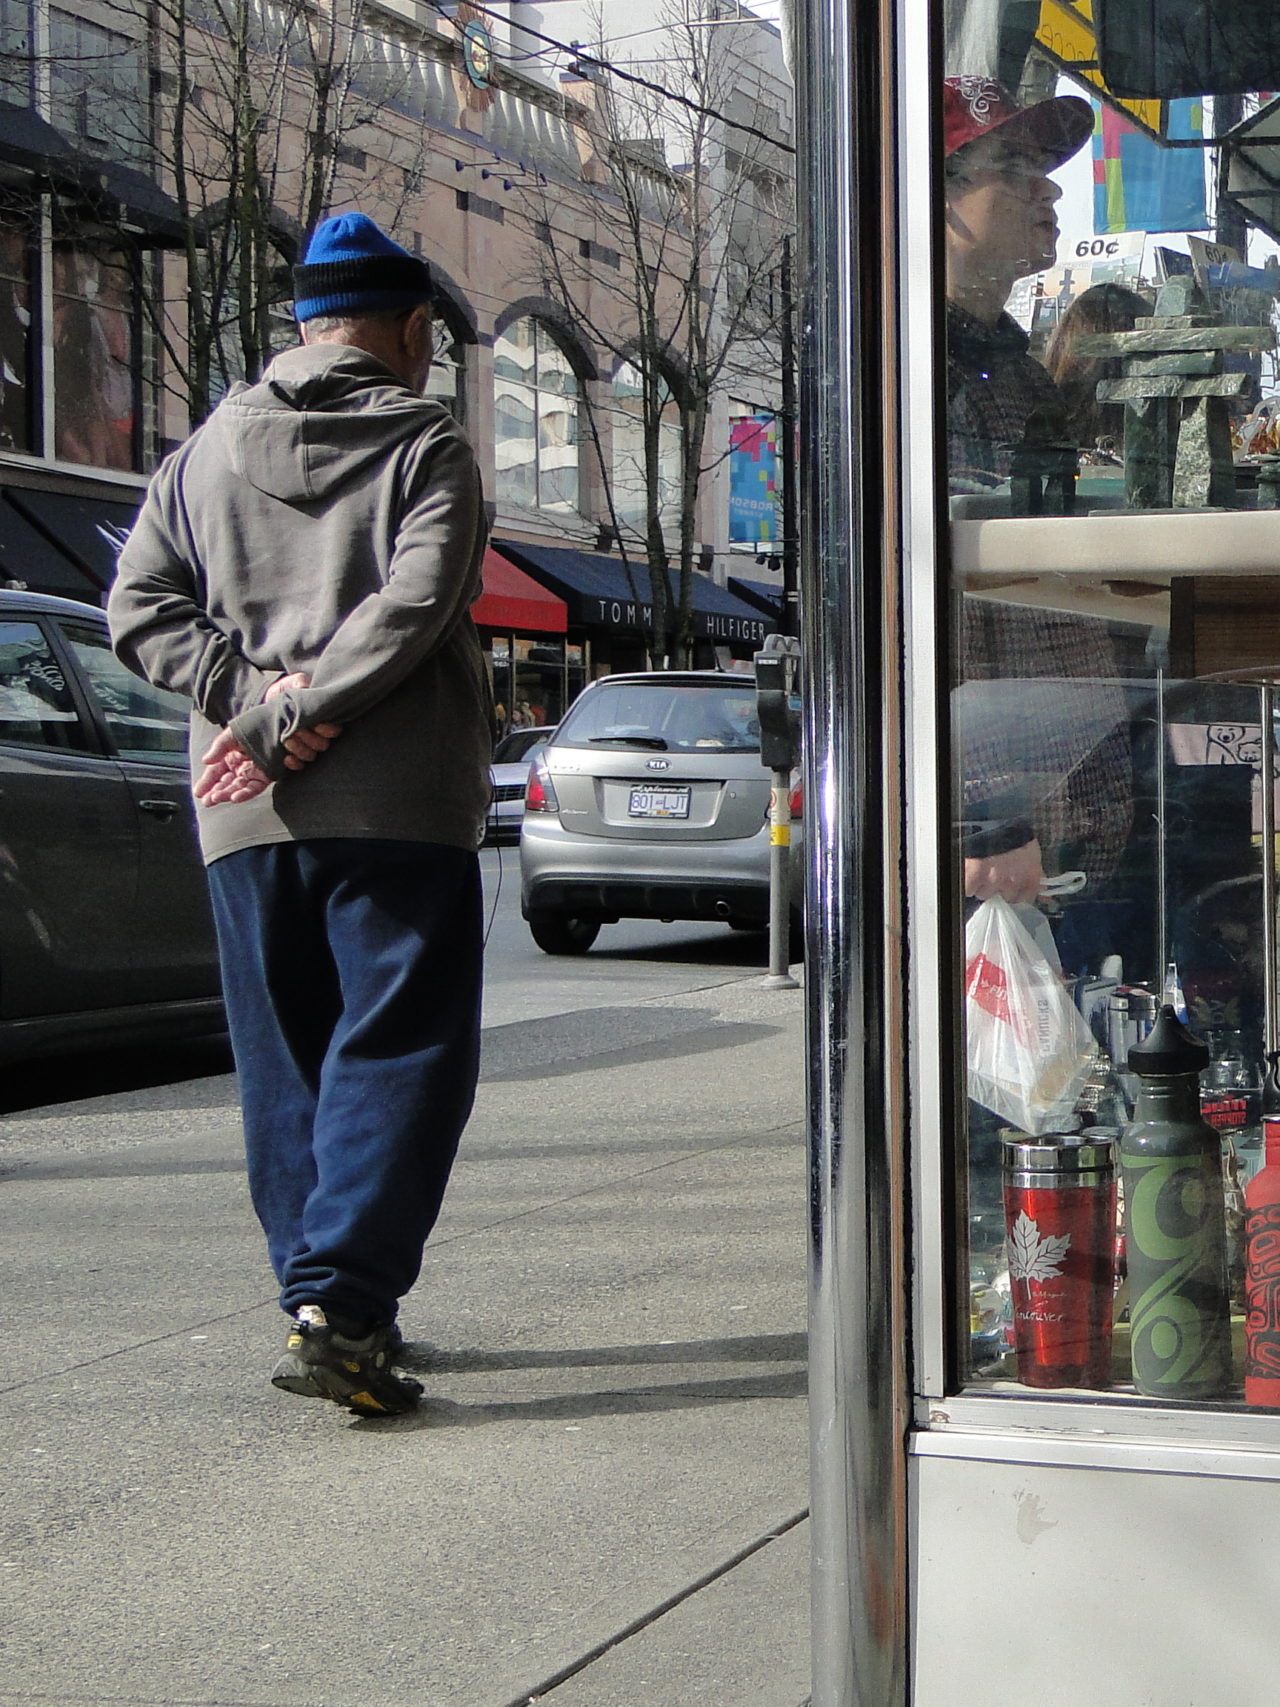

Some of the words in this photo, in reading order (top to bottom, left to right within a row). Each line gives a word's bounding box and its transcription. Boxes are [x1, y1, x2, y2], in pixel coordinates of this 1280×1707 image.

[1075, 238, 1120, 258] 60¢
[599, 600, 653, 626] TOMM
[706, 615, 766, 641] HILFIGER
[650, 760, 667, 769] KIA
